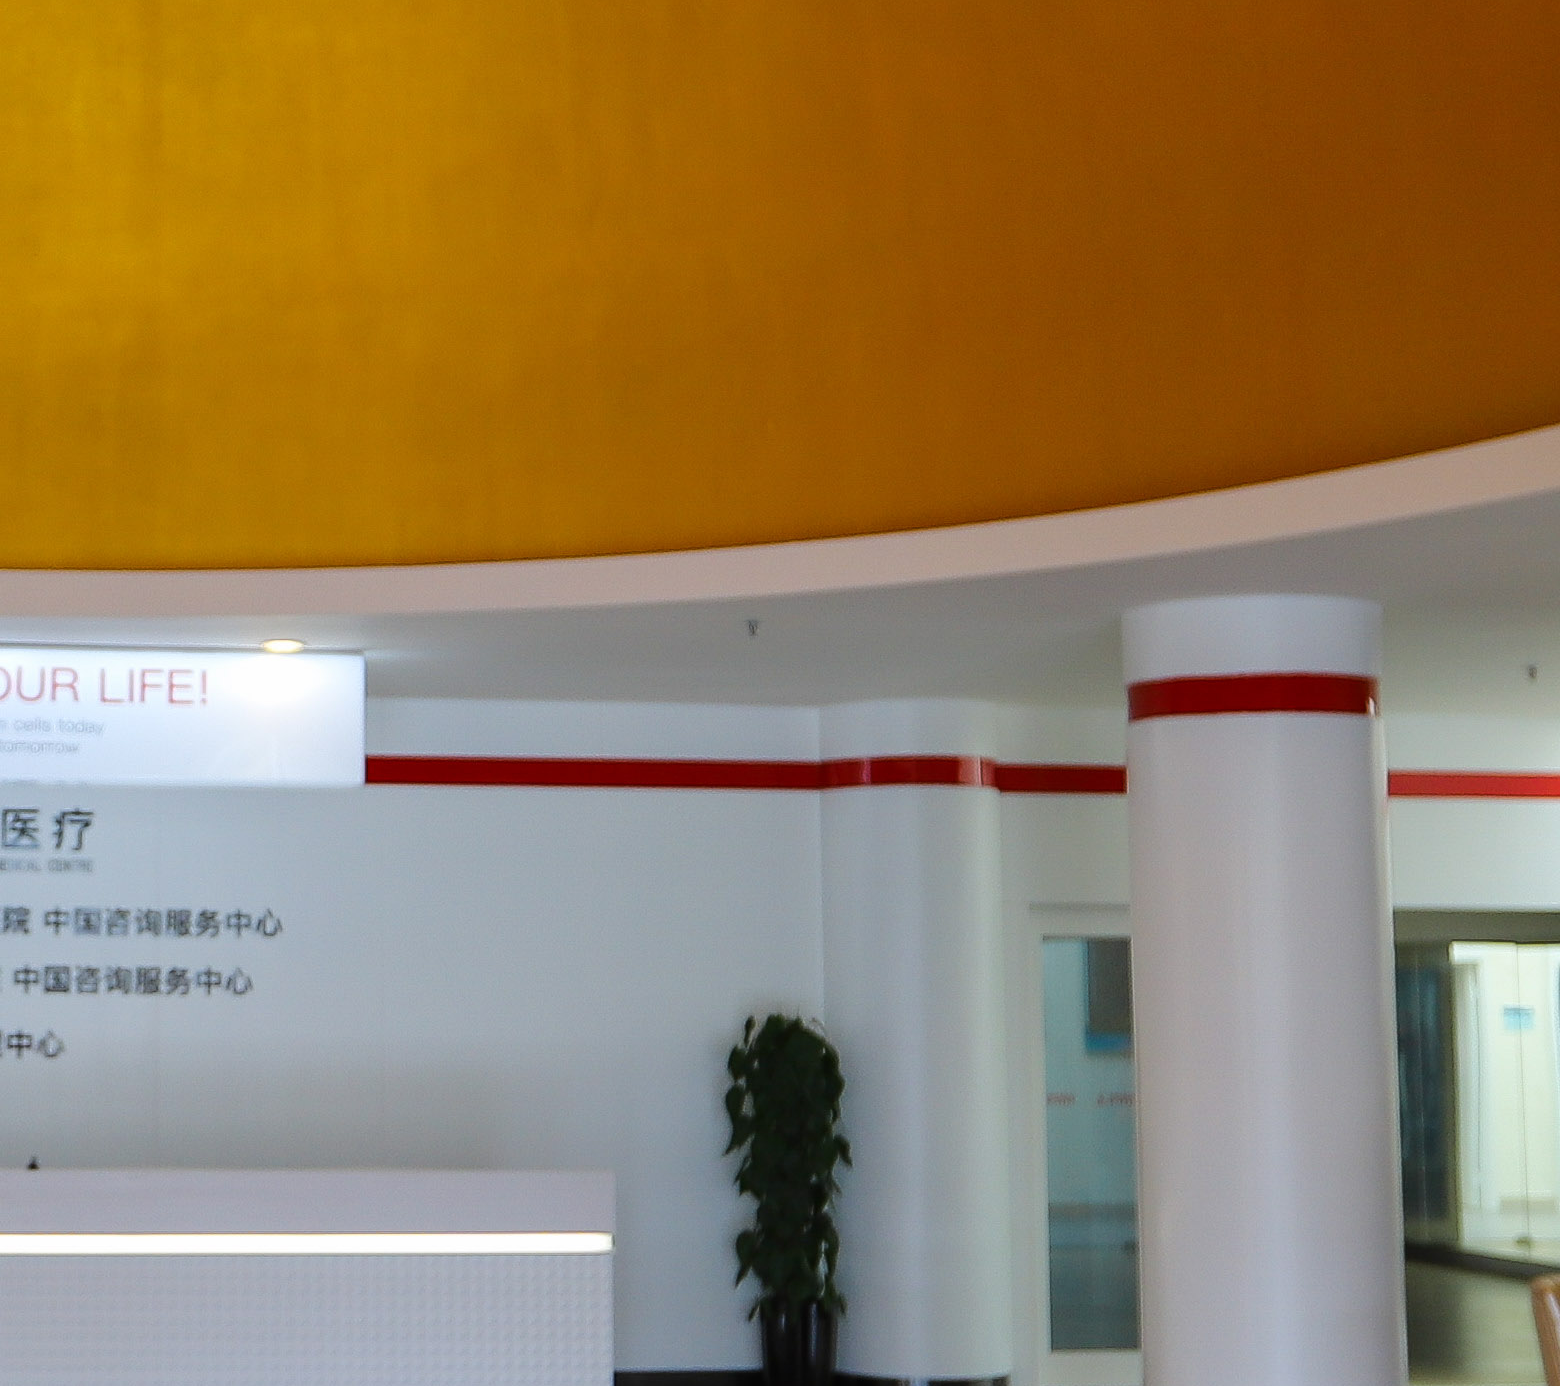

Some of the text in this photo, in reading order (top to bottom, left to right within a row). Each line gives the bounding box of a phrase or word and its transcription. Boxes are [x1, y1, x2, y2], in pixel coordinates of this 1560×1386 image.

[99, 668, 210, 706] LIFE!
[13, 717, 51, 733] cells
[57, 717, 105, 737] today
[44, 906, 283, 939] 中国咨询服务中心
[14, 965, 252, 997] 中国咨询服务中心
